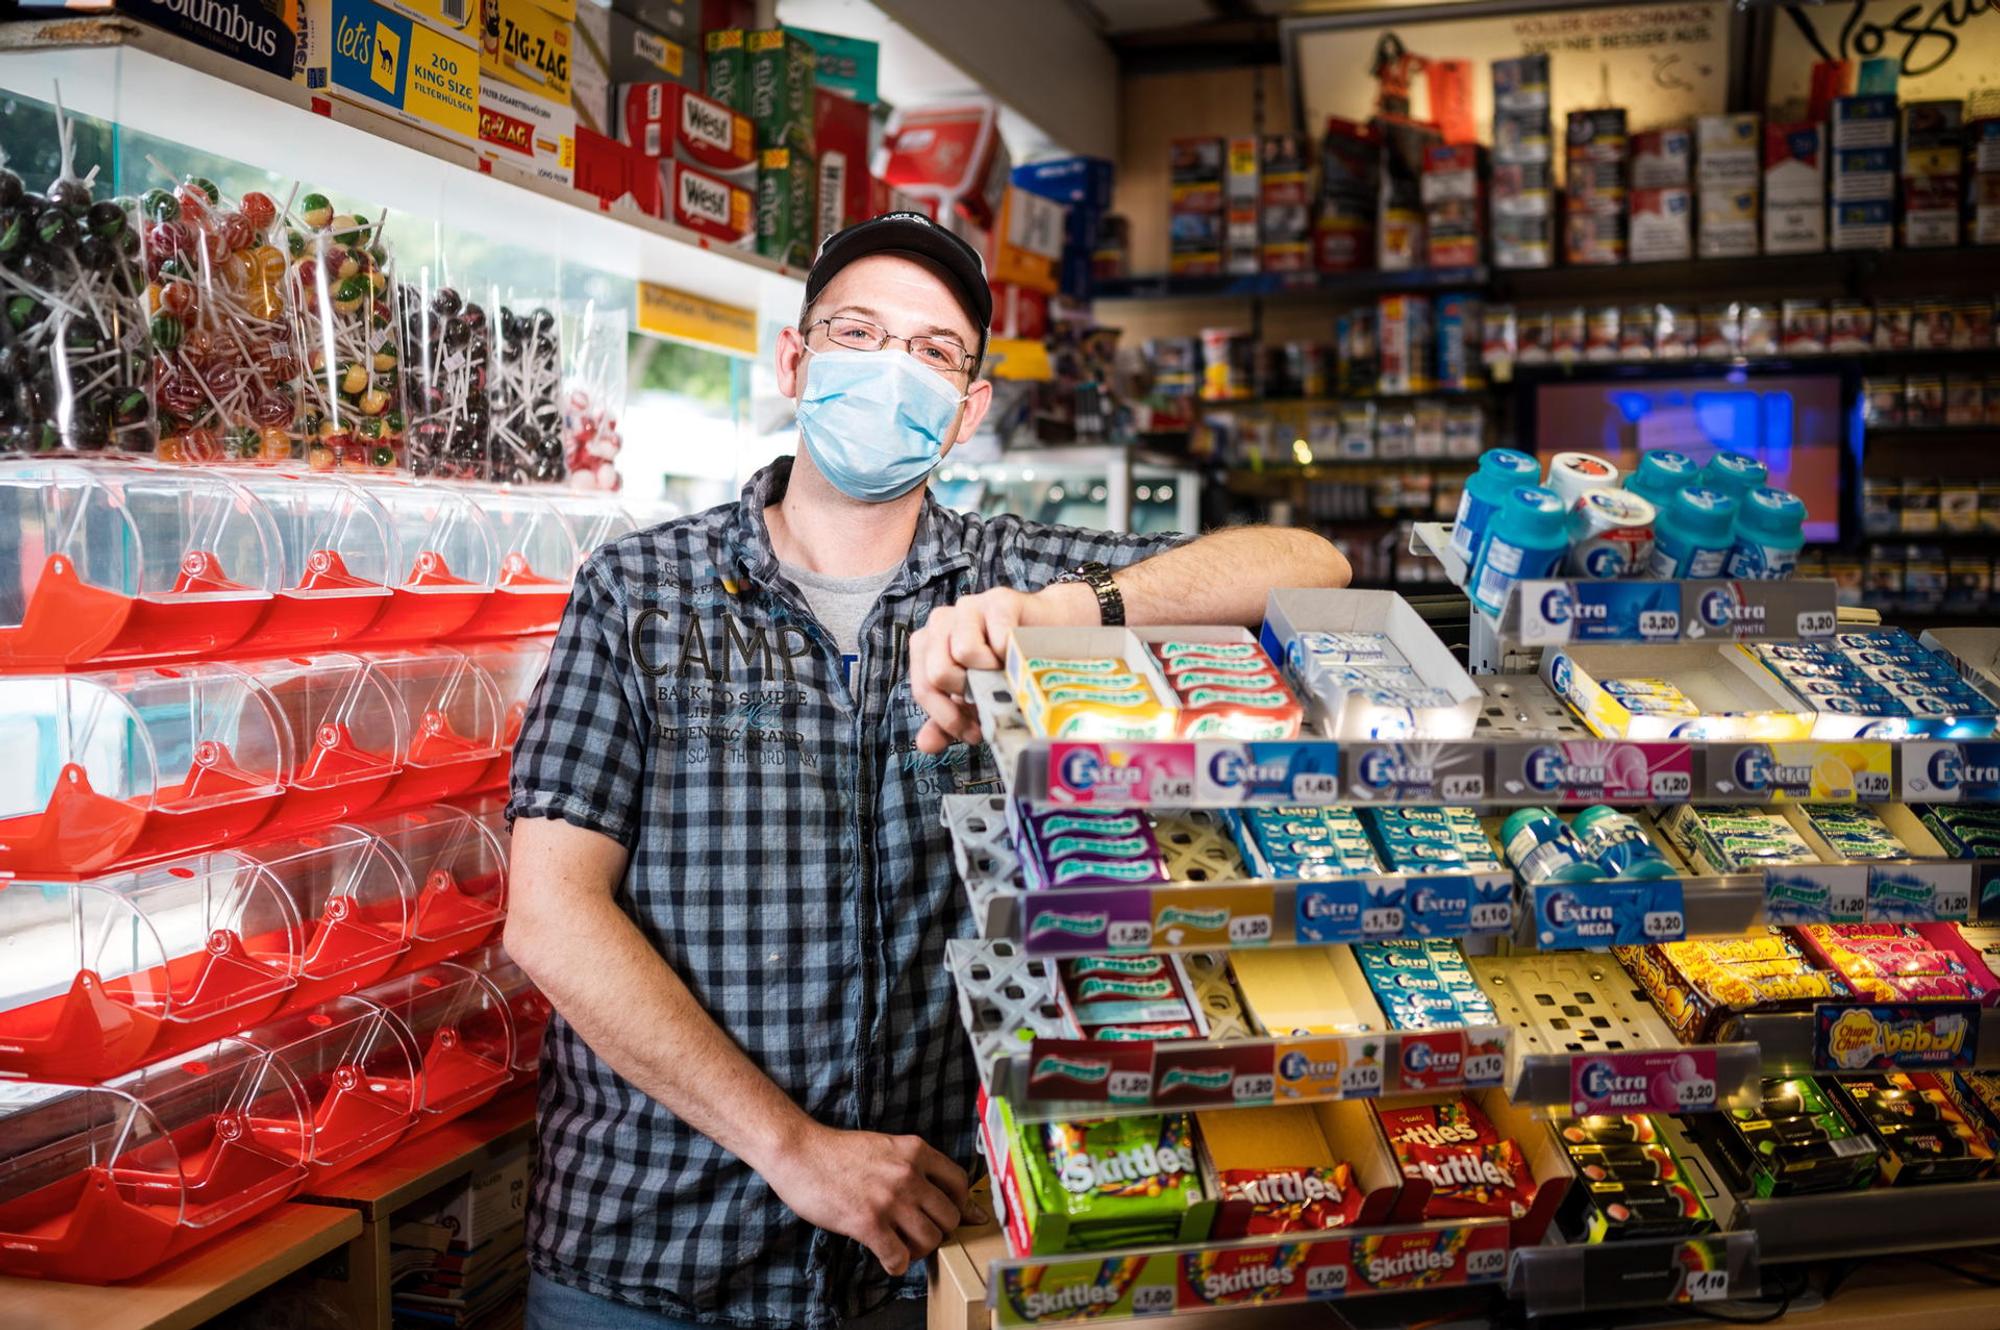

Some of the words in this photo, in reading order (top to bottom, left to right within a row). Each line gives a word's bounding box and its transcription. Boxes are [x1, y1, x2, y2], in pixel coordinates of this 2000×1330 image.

[152, 0, 277, 57] olumbus
[337, 15, 371, 65] let's
[504, 18, 567, 81] ZIG-ZAG
[431, 53, 458, 76] 200
[414, 64, 445, 88] KING
[447, 79, 473, 100] SIZE
[687, 99, 729, 147] West
[684, 176, 726, 223] West
[1550, 599, 1607, 620] Extra
[1709, 599, 1766, 620] Extra
[1648, 615, 1676, 632] 3,20
[1733, 623, 1765, 634] WHITE
[1806, 615, 1833, 632] 3,20
[631, 607, 813, 683] CAMP
[658, 685, 702, 701] BACK
[739, 690, 808, 707] SIMPLE
[1071, 757, 1141, 789] Extra
[1218, 756, 1286, 783] Extra
[1369, 757, 1434, 784] Extra
[1535, 757, 1606, 785] Extra
[1745, 757, 1812, 784] Extra
[1937, 756, 2000, 781] Extra
[1661, 778, 1689, 793] 1,20
[1864, 777, 1889, 791] 1,20
[1306, 898, 1359, 919] Extra
[1416, 893, 1467, 912] Extra
[1554, 899, 1613, 922] Extra
[1840, 899, 1865, 913] 1,20
[1944, 898, 1968, 911] 1,20
[1372, 910, 1400, 927] 1,10
[1480, 909, 1508, 924] 1,10
[1653, 916, 1681, 933] 3,20
[1238, 921, 1268, 938] 1,20
[1577, 923, 1615, 936] MEGA
[1286, 1057, 1337, 1074] Extra
[1410, 1050, 1460, 1067] Extra
[1474, 1058, 1501, 1074] 1,10
[1120, 1079, 1149, 1093] 1,20
[1244, 1081, 1273, 1096] 1,20
[1350, 1071, 1378, 1087] 1,10
[1589, 1072, 1647, 1092] Extra
[1610, 1093, 1647, 1106] MEGA
[1686, 1085, 1713, 1101] 3,20
[1062, 1143, 1195, 1193] Skittles
[1368, 1248, 1456, 1283] Skittles
[1477, 1253, 1504, 1269] 1,00
[1203, 1265, 1294, 1300] Skittles
[1316, 1270, 1345, 1287] 1,00
[1024, 1284, 1119, 1319] Skittles
